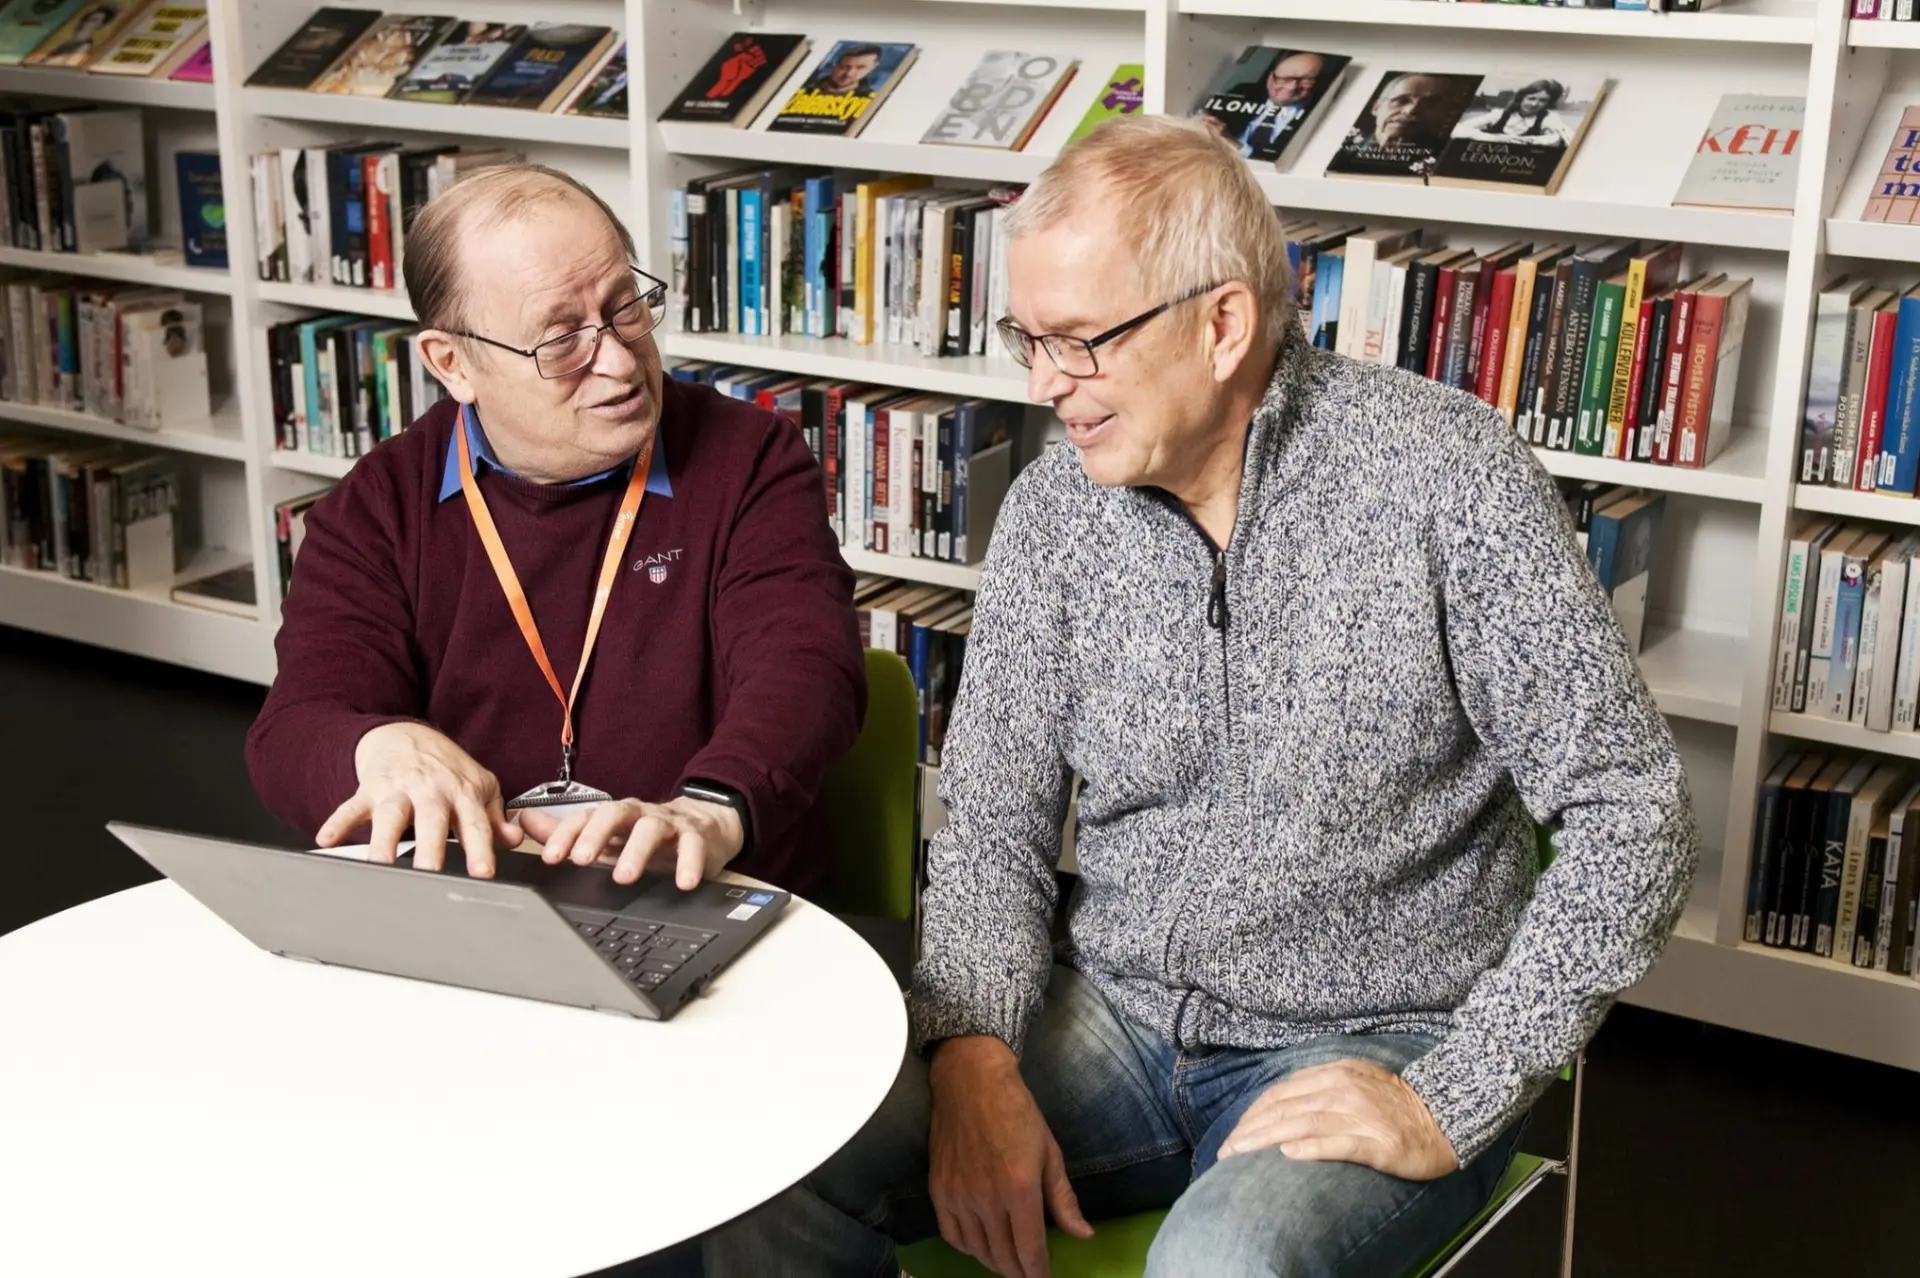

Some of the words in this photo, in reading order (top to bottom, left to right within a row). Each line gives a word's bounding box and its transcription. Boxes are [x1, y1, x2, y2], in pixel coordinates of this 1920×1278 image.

[1205, 98, 1305, 120] ILONIEMI
[1466, 141, 1509, 154] EEVA
[1562, 309, 1580, 355] ANTERO
[1614, 321, 1635, 375] KULLERVO
[1854, 340, 1866, 363] JAN
[1554, 356, 1573, 412] SVENSSON
[1608, 378, 1628, 422] MANNER
[876, 445, 886, 479] HANNA
[633, 548, 683, 572] GANT
[1820, 840, 1844, 888] KATA
